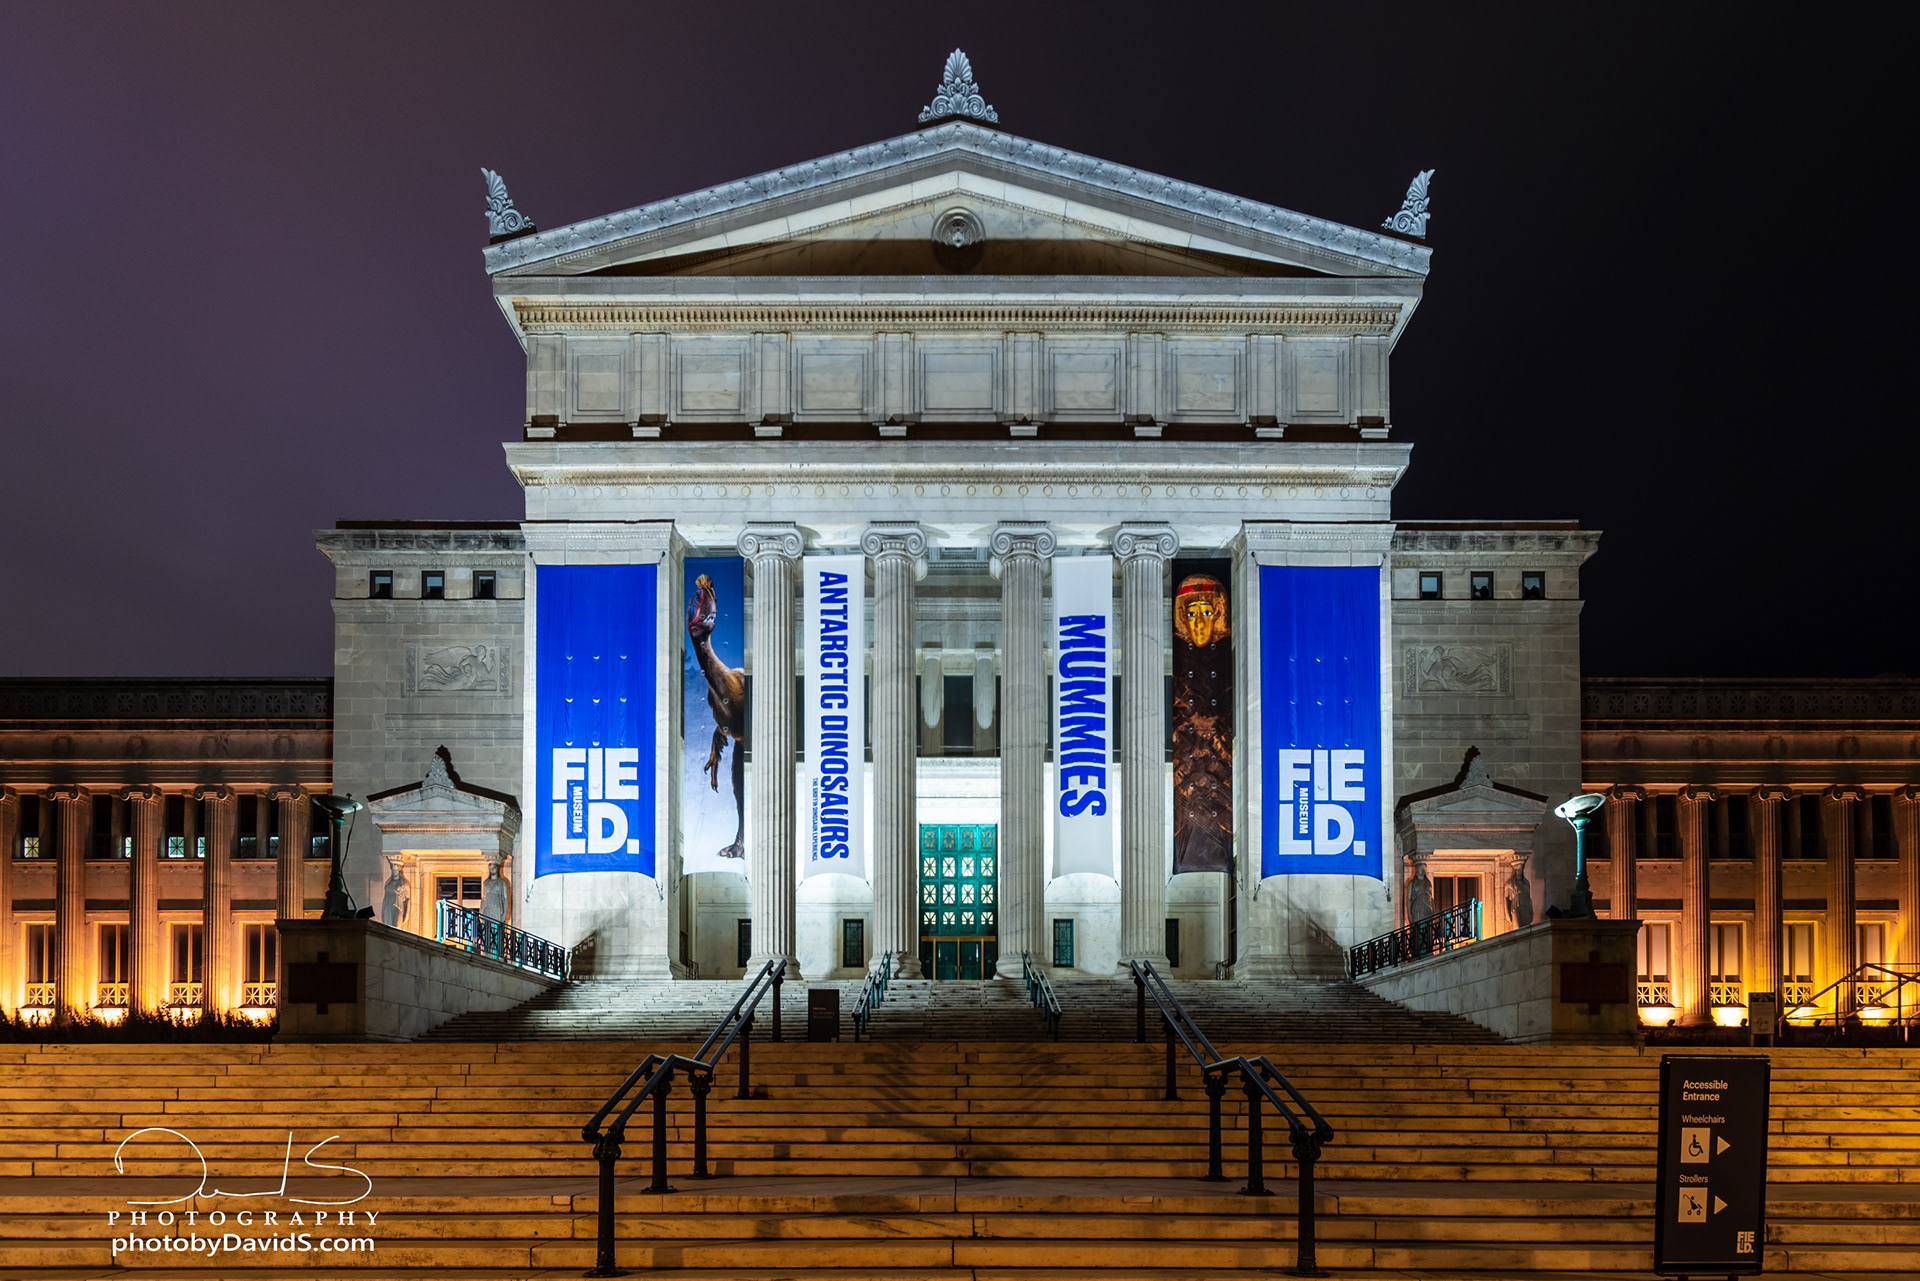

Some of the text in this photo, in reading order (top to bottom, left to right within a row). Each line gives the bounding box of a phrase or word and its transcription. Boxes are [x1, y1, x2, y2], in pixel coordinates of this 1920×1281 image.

[819, 571, 849, 860] ANTARCTIC DINOSAURS
[1059, 615, 1107, 818] MUMMIES
[573, 786, 583, 833] MUSEUM
[1299, 787, 1309, 834] MUSEUM
[1683, 1080, 1728, 1090] Accessible
[1683, 1092, 1720, 1101] Entrance
[1682, 1114, 1726, 1124] Wheelchairs
[1679, 1174, 1709, 1183] Strollers
